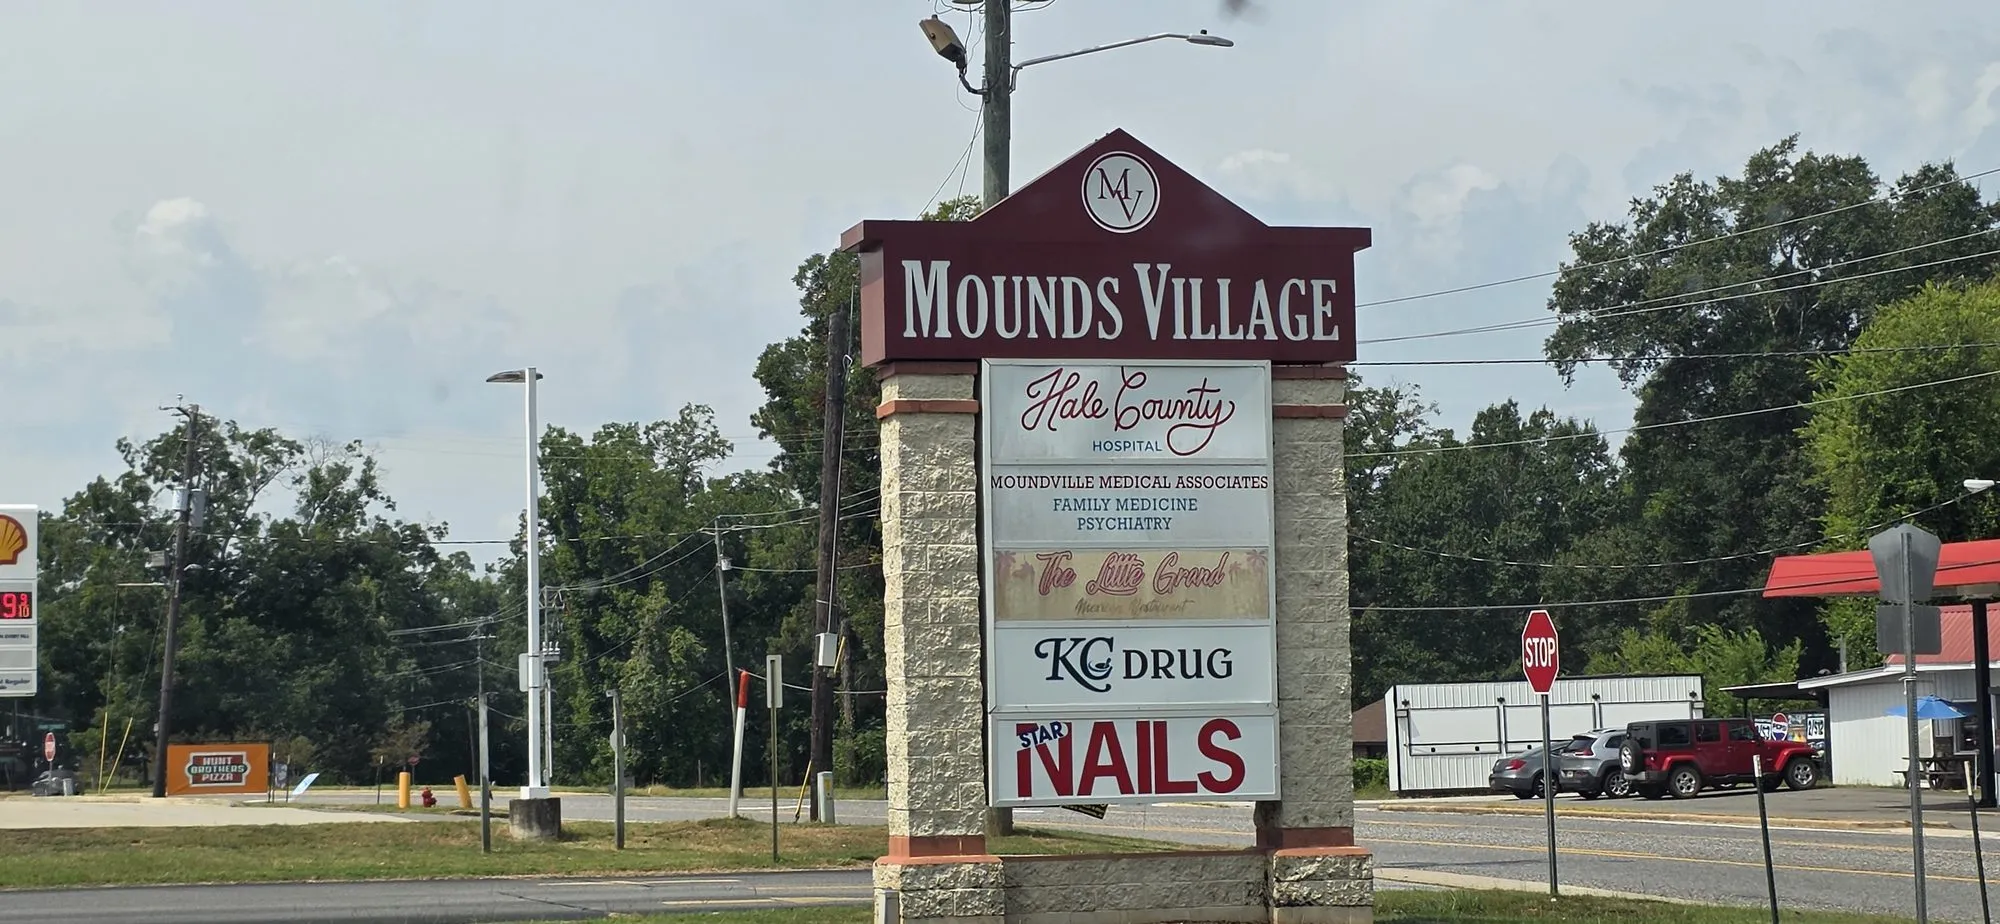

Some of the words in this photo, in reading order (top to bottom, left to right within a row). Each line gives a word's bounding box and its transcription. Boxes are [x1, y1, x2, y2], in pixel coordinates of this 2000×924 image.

[902, 260, 1123, 340] MOUNDS
[1133, 263, 1339, 341] VILLAGE
[1021, 367, 1109, 432] Hale
[1114, 366, 1236, 456] County
[1092, 440, 1163, 452] HOSPITAL
[991, 475, 1095, 489] MOUNDVILLE
[1099, 475, 1171, 489] MEDICAL
[1175, 475, 1268, 489] ASSOCIATES
[1053, 498, 1111, 512] FAMILY
[1115, 498, 1198, 511] MEDICINE
[1077, 516, 1173, 531] PSYCHIATRY
[1036, 551, 1077, 596] The
[1086, 551, 1145, 596] Little
[1152, 551, 1230, 595] Grand
[1525, 637, 1556, 668] STOP
[1034, 636, 1115, 693] KC
[1122, 648, 1233, 679] DRUG
[1019, 721, 1064, 748] STAR
[203, 756, 232, 765] HUNT
[1016, 718, 1246, 798] NAILS
[190, 765, 245, 774] BROTHERS
[202, 773, 234, 781] PIZZA
